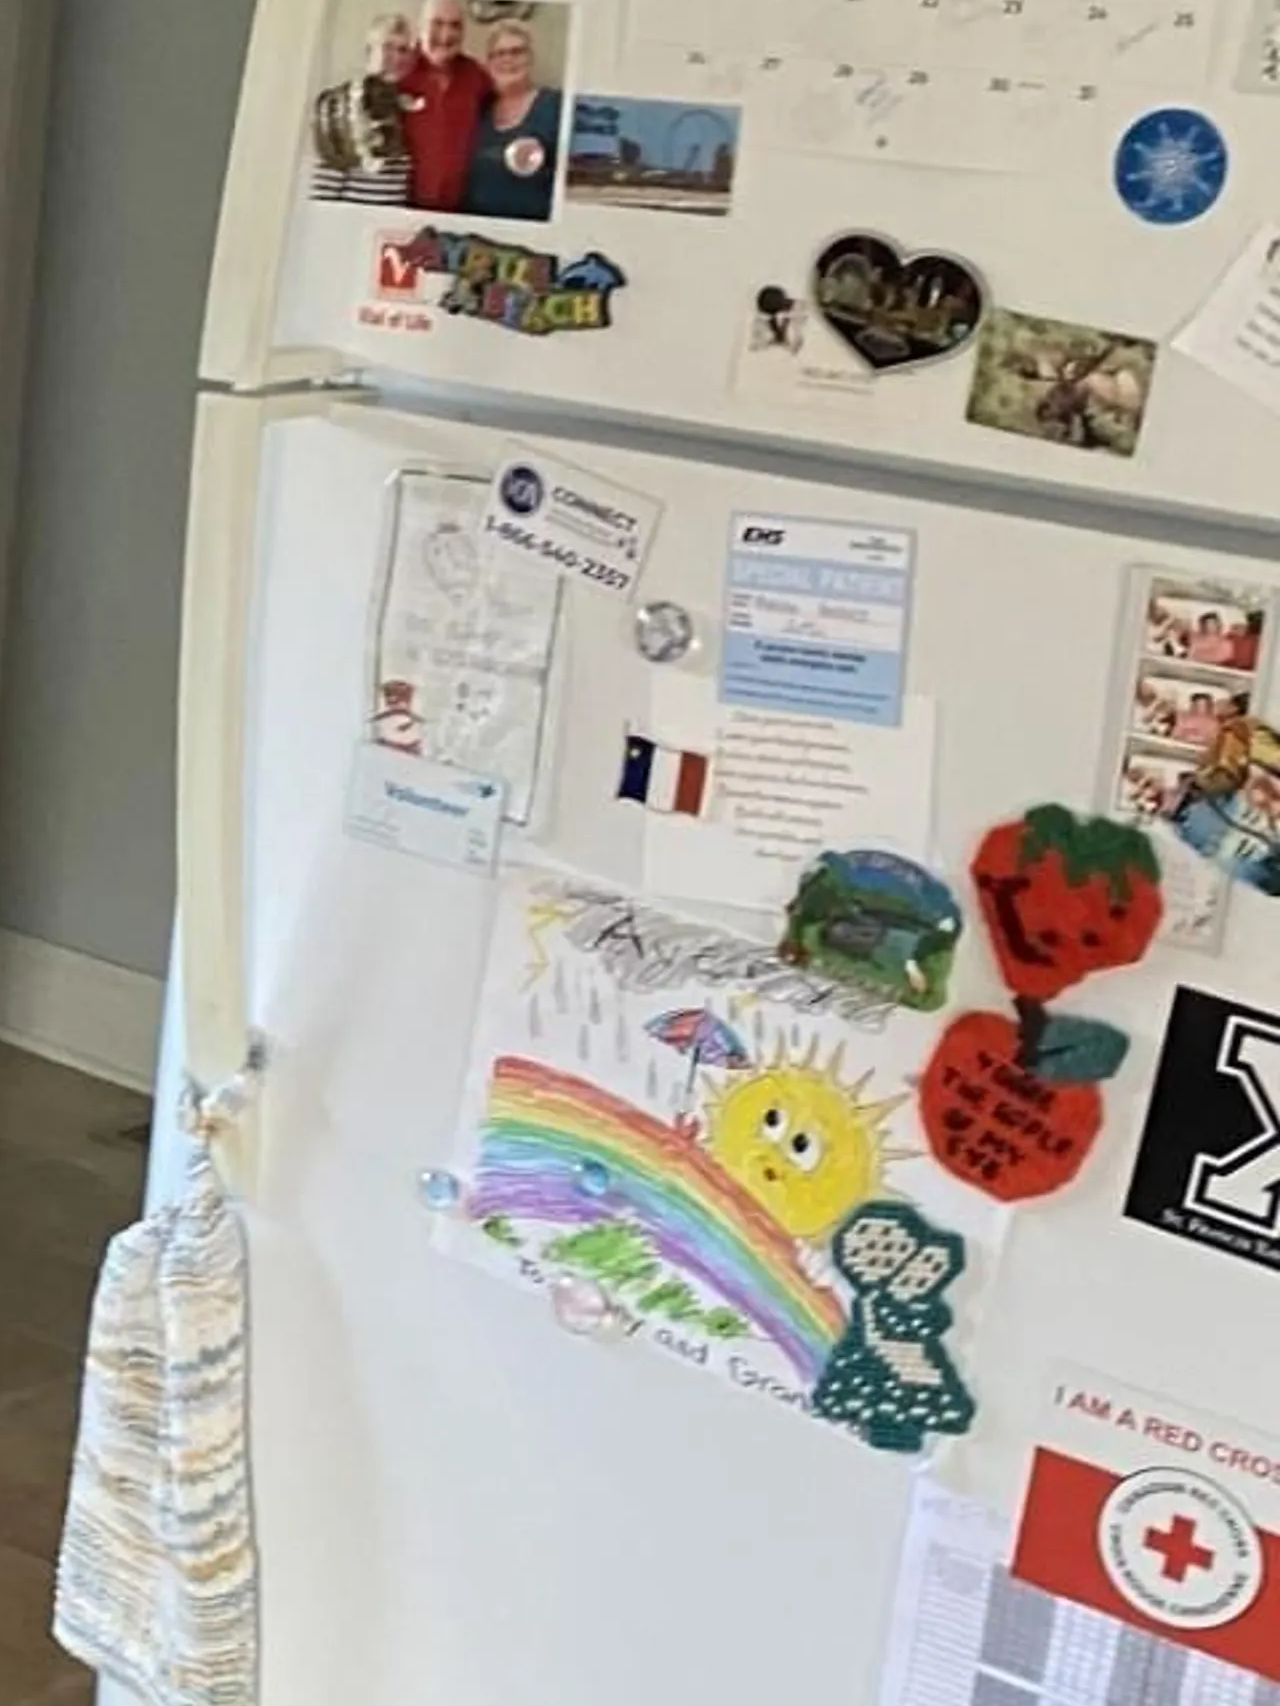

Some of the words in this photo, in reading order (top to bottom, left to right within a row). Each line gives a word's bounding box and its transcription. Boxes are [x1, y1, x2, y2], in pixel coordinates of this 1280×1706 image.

[552, 486, 638, 532] CONNECT
[652, 1327, 710, 1366] and
[727, 1354, 814, 1414] Gran
[1053, 1385, 1065, 1405] I
[1067, 1391, 1111, 1421] AM
[1115, 1407, 1138, 1432] A
[1143, 1416, 1204, 1453] RED
